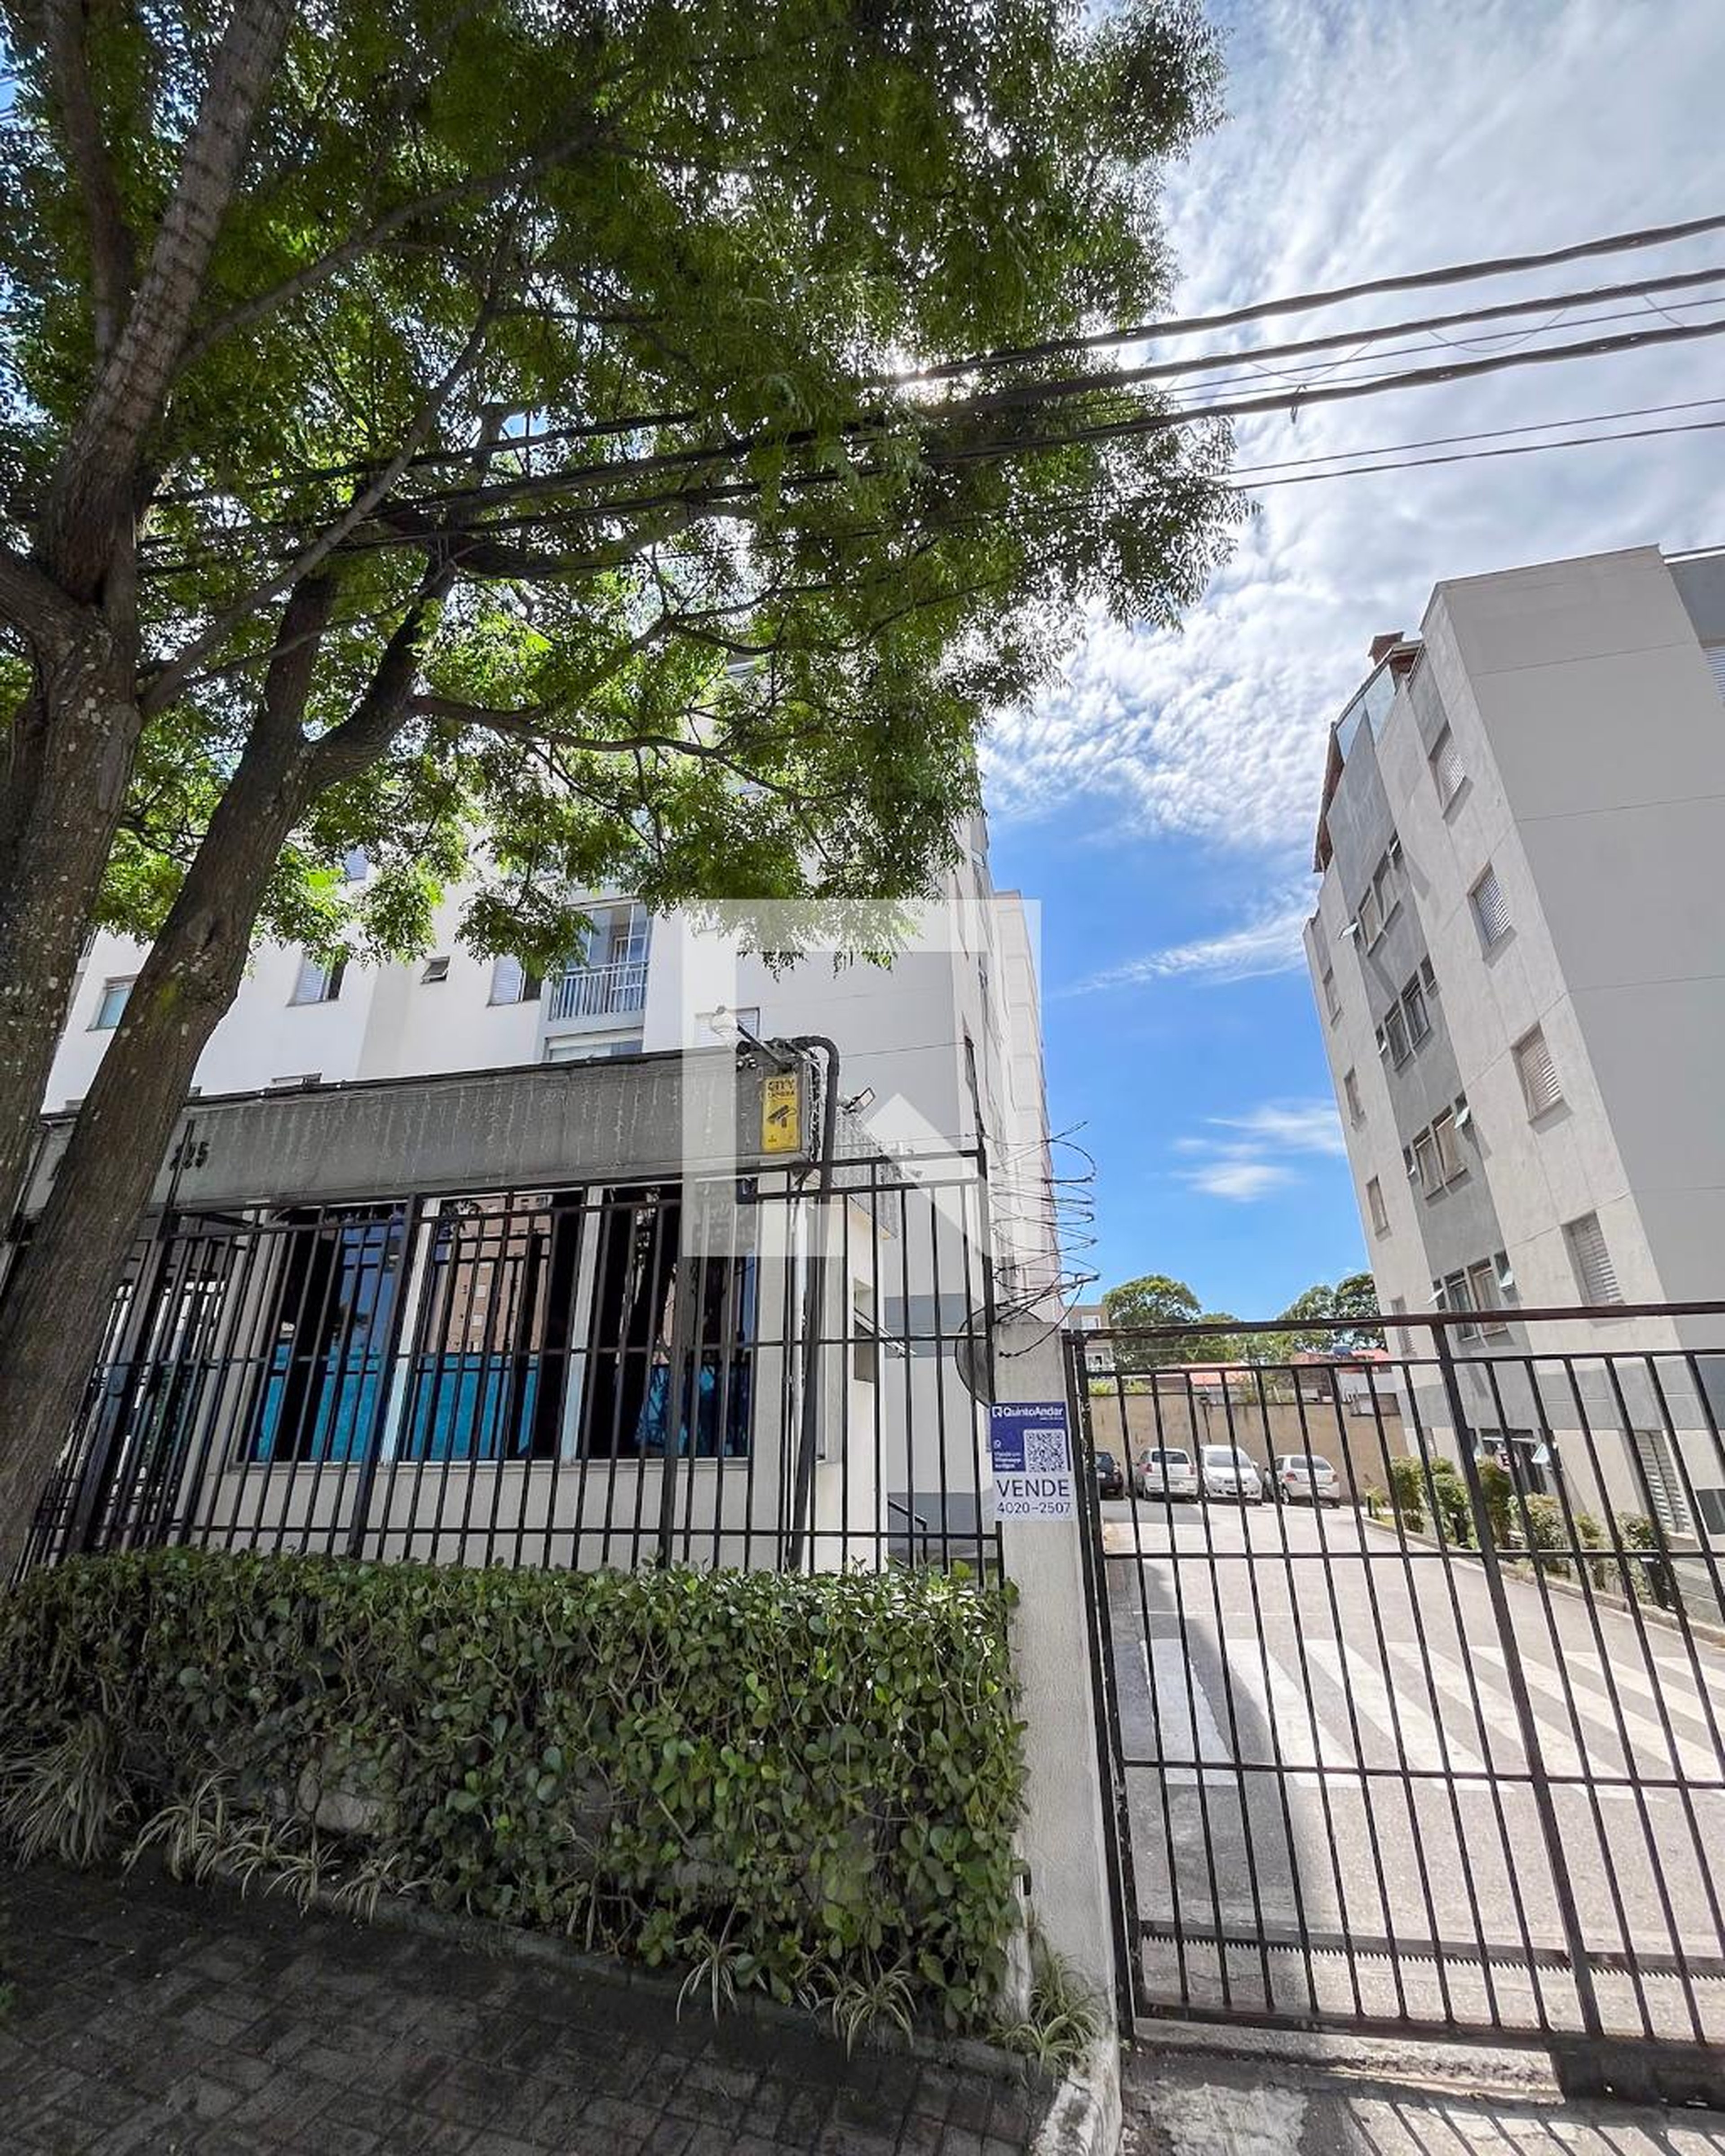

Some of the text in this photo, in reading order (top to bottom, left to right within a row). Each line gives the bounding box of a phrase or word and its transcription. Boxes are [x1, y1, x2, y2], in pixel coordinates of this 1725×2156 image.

[1003, 1406, 1064, 1417] QuintoAndar
[996, 1480, 1070, 1497] VENDE
[997, 1502, 1070, 1513] 4020-2507
